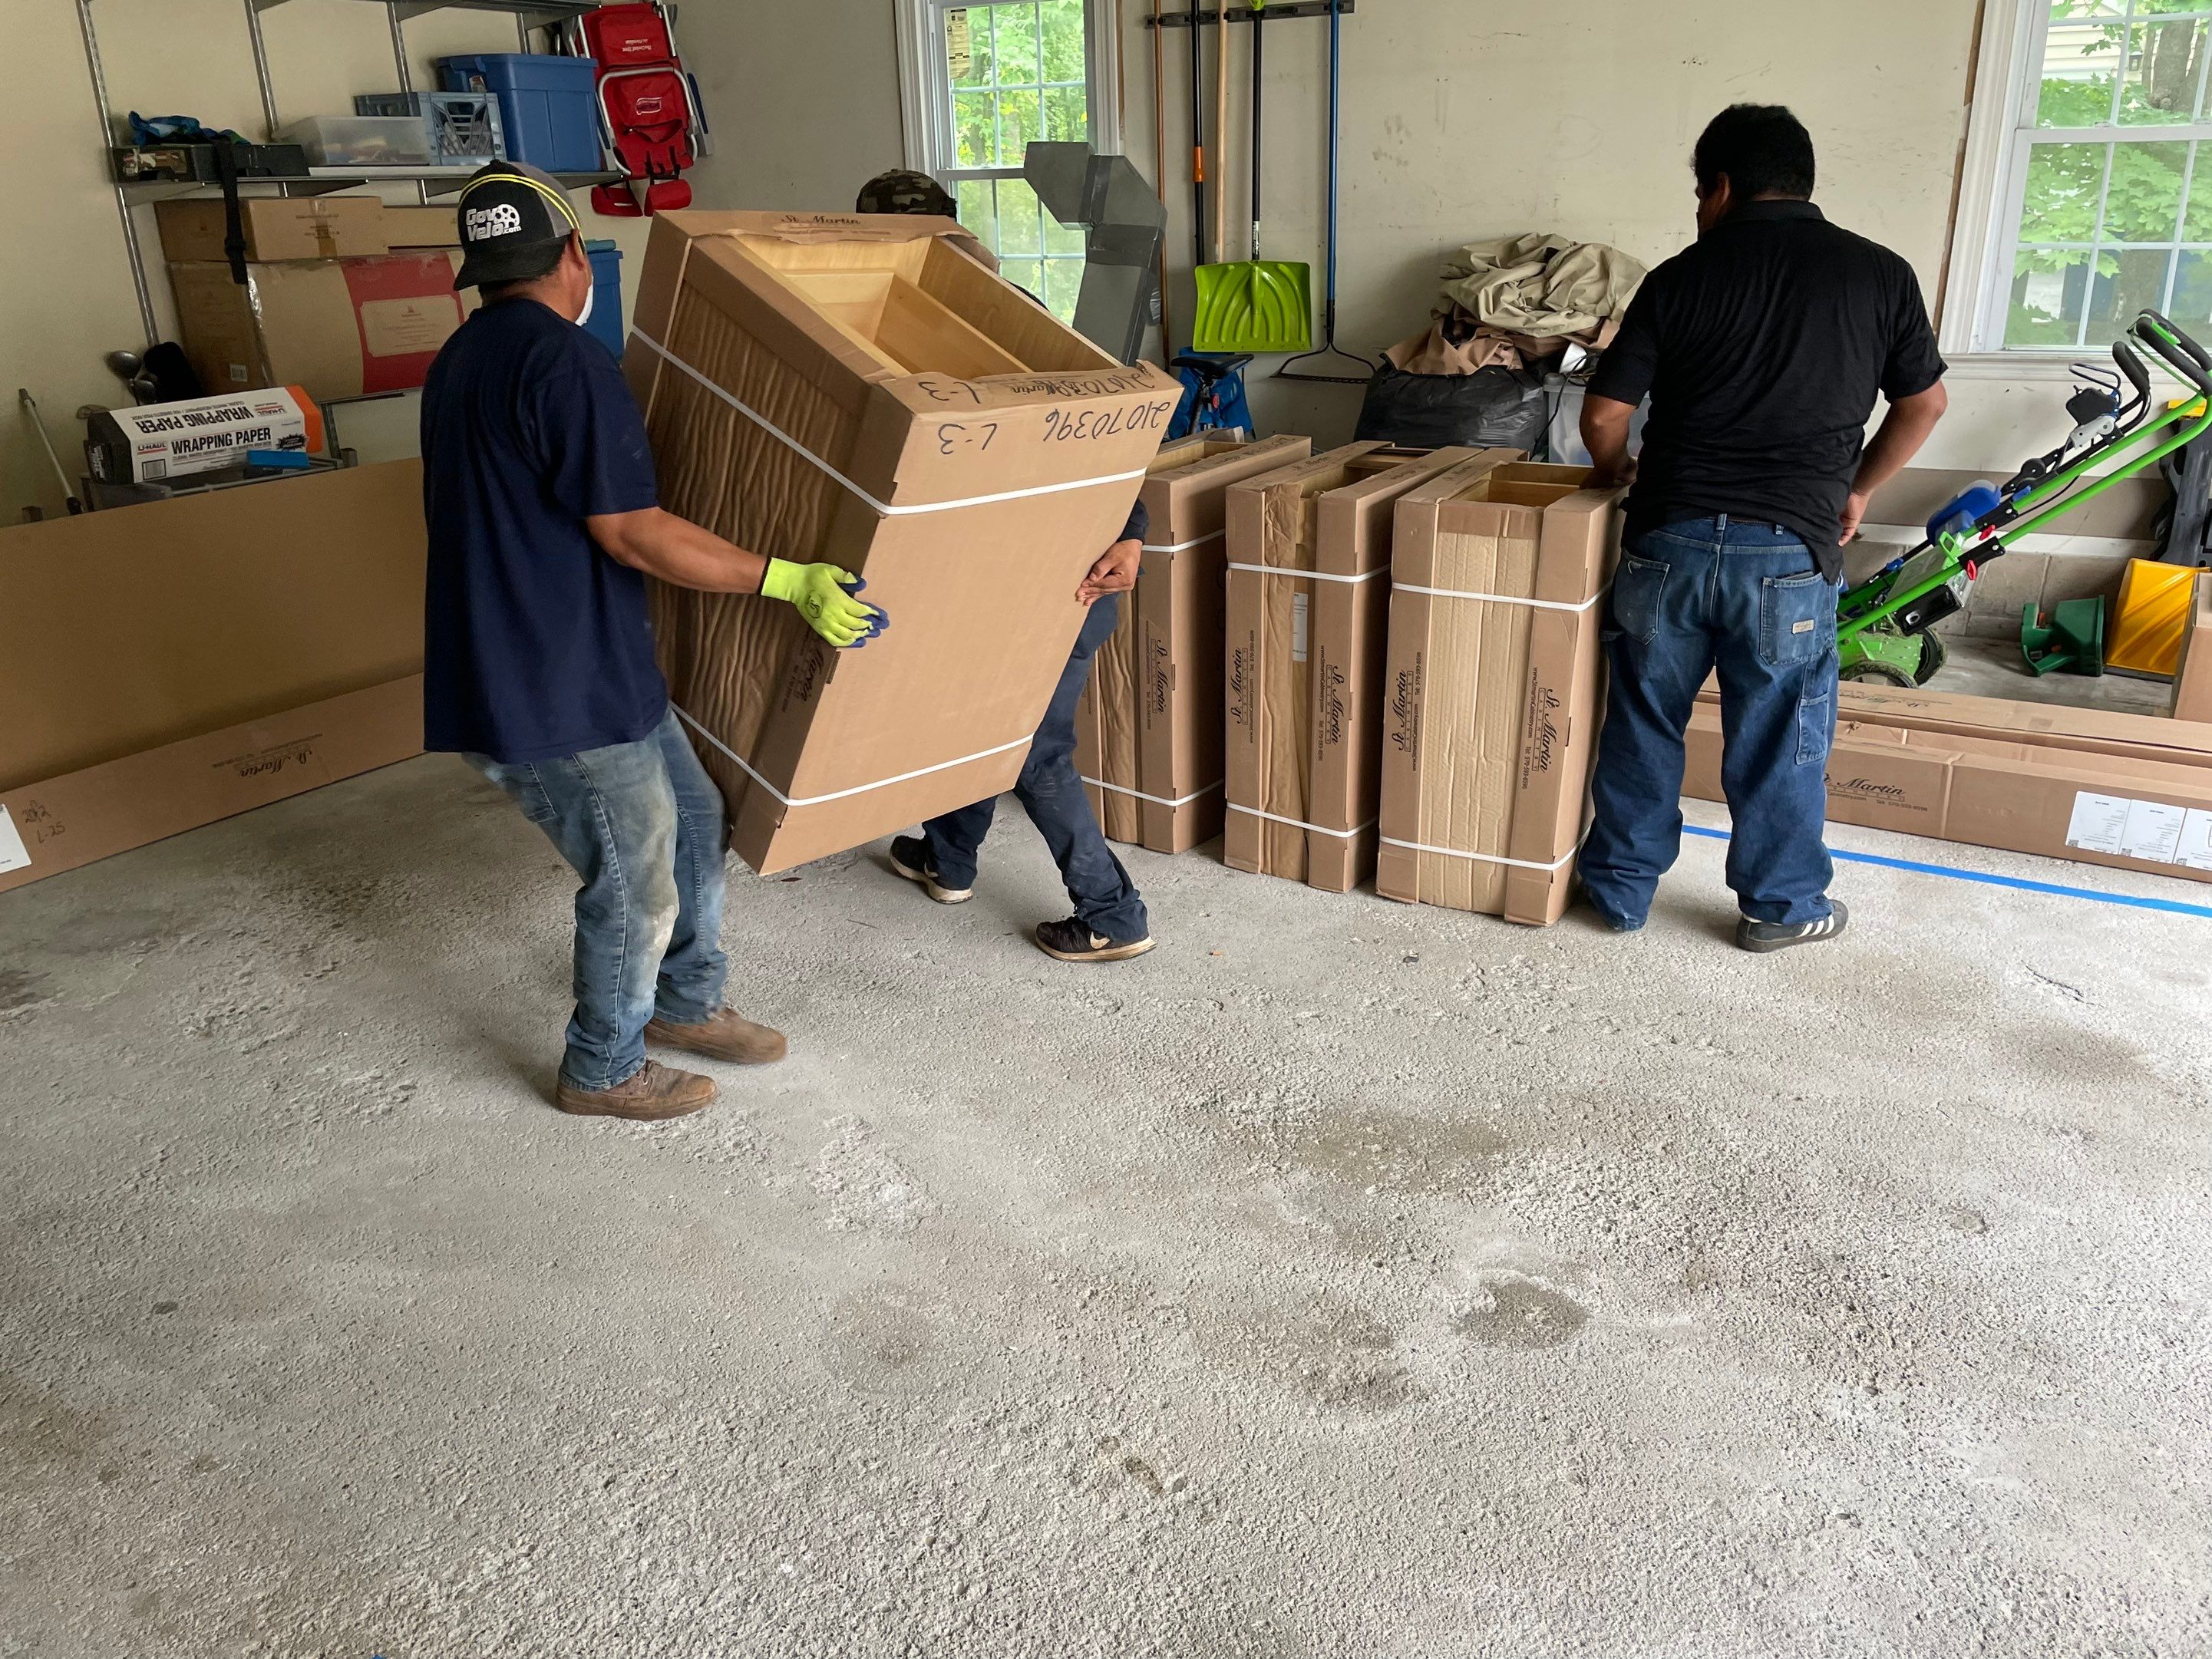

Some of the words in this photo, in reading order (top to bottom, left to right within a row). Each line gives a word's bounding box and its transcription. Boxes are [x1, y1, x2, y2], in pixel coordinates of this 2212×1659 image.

[813, 215, 860, 225] Martin
[135, 416, 184, 434] PAPER
[182, 406, 254, 427] WRAPPING
[1043, 401, 1171, 442] 21070396
[171, 433, 233, 454] WRAPPING
[236, 427, 271, 445] PAPER
[937, 422, 998, 455] L-3
[1157, 661, 1168, 715] Martin
[1230, 647, 1242, 702] Martin
[1392, 669, 1406, 727] Martin
[1332, 689, 1344, 746] Martin
[1540, 713, 1557, 773] Martin
[239, 755, 291, 777] Martin
[1836, 777, 1907, 796] Martin
